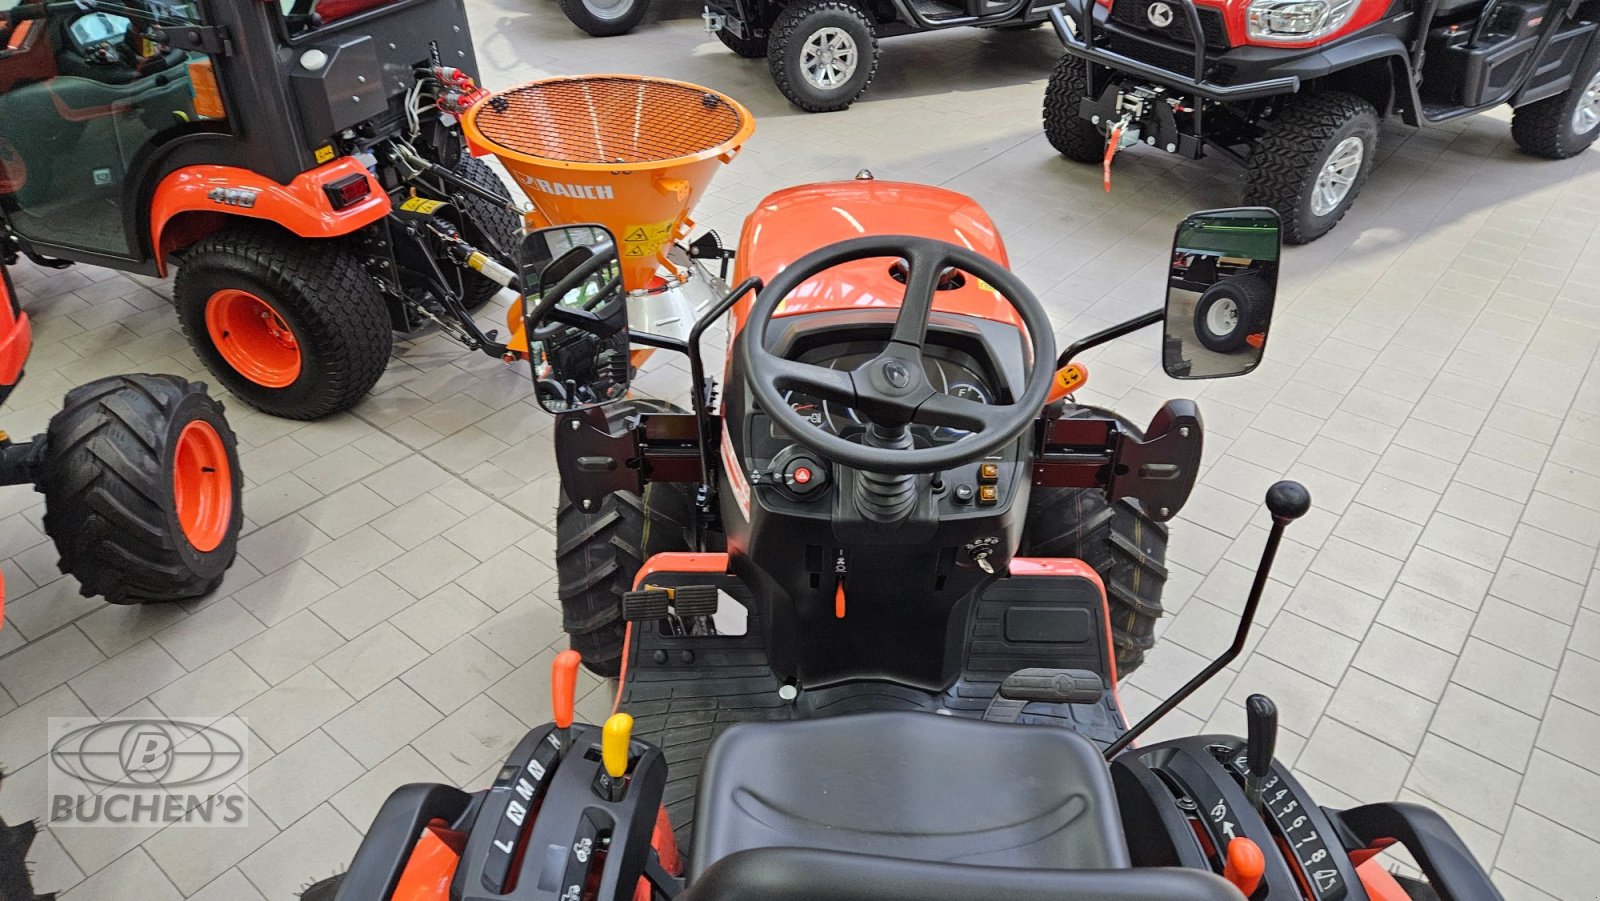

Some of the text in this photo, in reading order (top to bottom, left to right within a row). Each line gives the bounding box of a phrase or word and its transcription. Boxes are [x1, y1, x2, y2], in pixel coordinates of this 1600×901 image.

[208, 187, 257, 208] 4WD
[536, 178, 614, 200] RAUCH
[958, 388, 966, 397] F
[1265, 776, 1327, 863] 3 4 5 6 7 8
